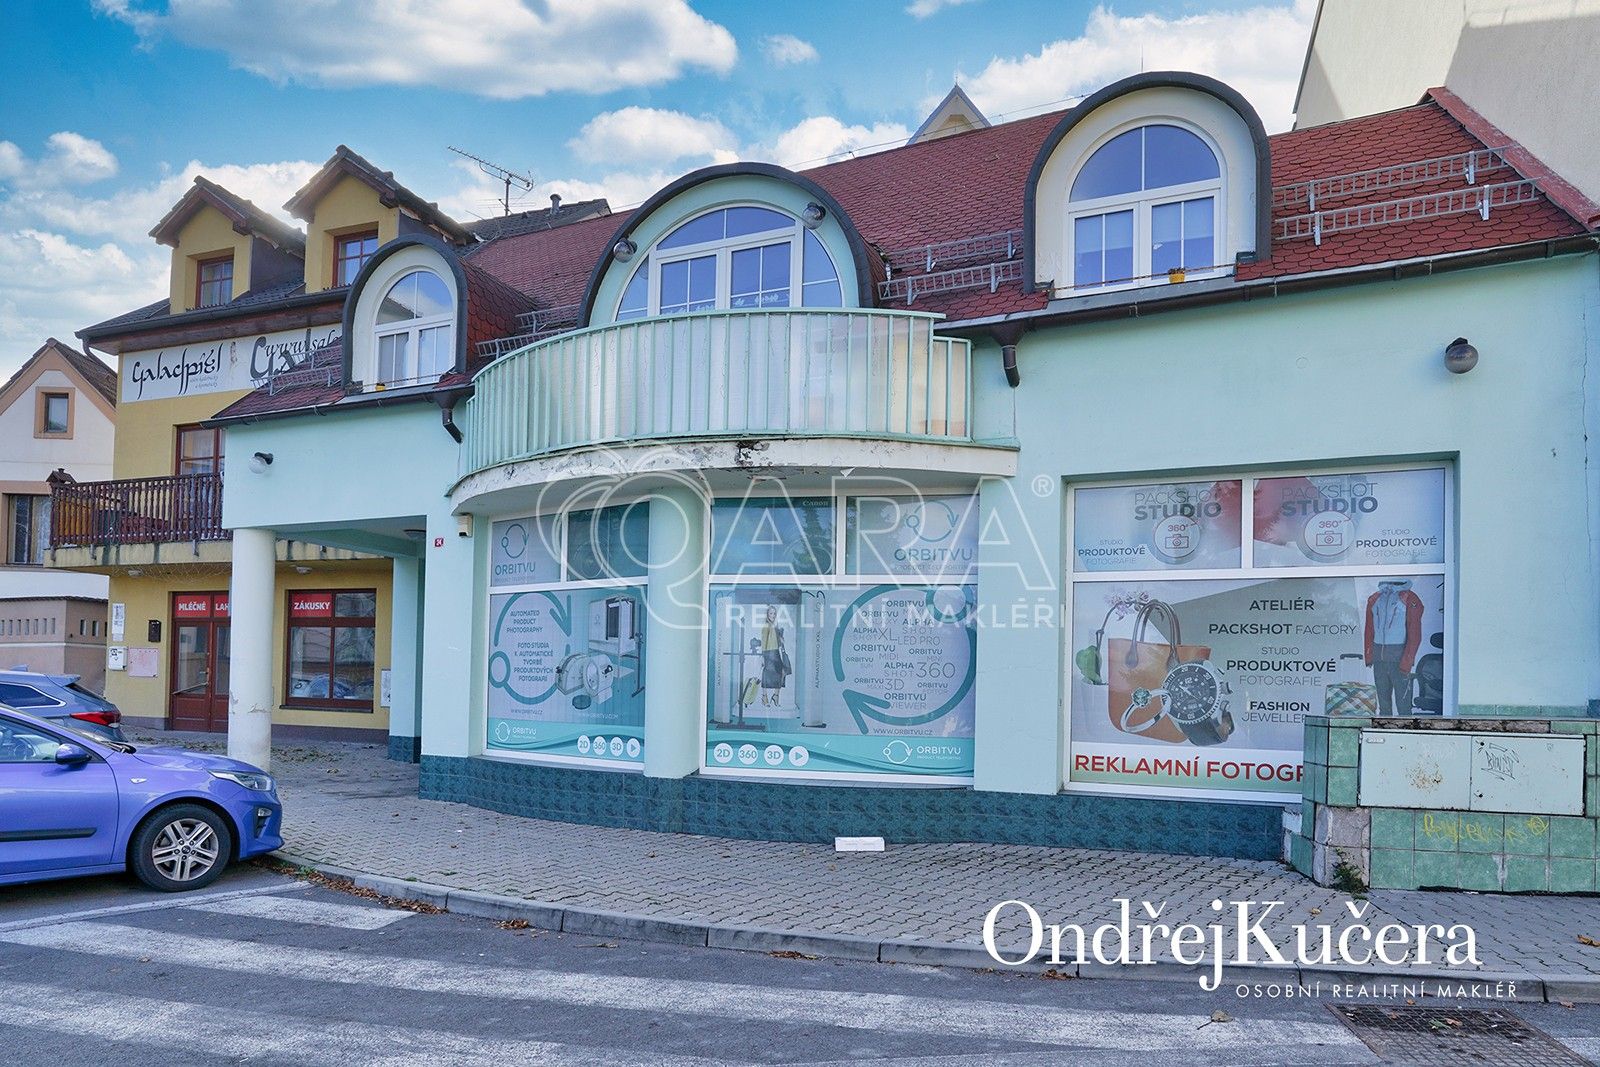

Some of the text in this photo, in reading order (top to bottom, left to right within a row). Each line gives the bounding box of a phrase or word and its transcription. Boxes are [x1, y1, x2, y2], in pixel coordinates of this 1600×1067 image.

[1281, 482, 1379, 499] PACKSHOT
[1134, 501, 1222, 521] STUDIO
[1281, 496, 1379, 517] STUDIO
[1381, 528, 1410, 536] STUDIO
[1356, 536, 1438, 549] PRODUKTOVÉ
[893, 548, 973, 562] ORBITVU
[1078, 545, 1146, 557] PRODUKTOVÉ
[1365, 549, 1428, 558] FOTOGRAFIE
[494, 561, 537, 576] ORBITVU
[178, 600, 207, 611] MLÉČNÉ
[293, 600, 331, 610] ZÁKUSKY
[886, 600, 925, 608] ORBITVU
[1249, 596, 1315, 611] ATELIÉR
[878, 627, 898, 641] XL
[1208, 623, 1358, 635] PACKSHOT FACTORY
[920, 636, 941, 646] PRO
[853, 644, 896, 653] ORBITVU
[1261, 646, 1300, 656] STUDIO
[884, 662, 915, 670] ALPHA
[915, 662, 956, 679] 360
[1226, 658, 1337, 673] PRODUKTOVÉ
[854, 677, 885, 685] ORBITVU
[884, 679, 905, 691] 3D
[1239, 675, 1322, 687] FOTOGRAFIE
[884, 692, 927, 702] ORBITVU
[1249, 701, 1311, 712] FASHION
[512, 727, 538, 736] ORBITVU
[593, 741, 607, 750] 360
[916, 745, 962, 755] ORBITVU
[716, 748, 731, 759] 2D
[738, 749, 757, 760] 360
[766, 750, 782, 760] 3D
[1074, 754, 1201, 778] REKLAMNÍ
